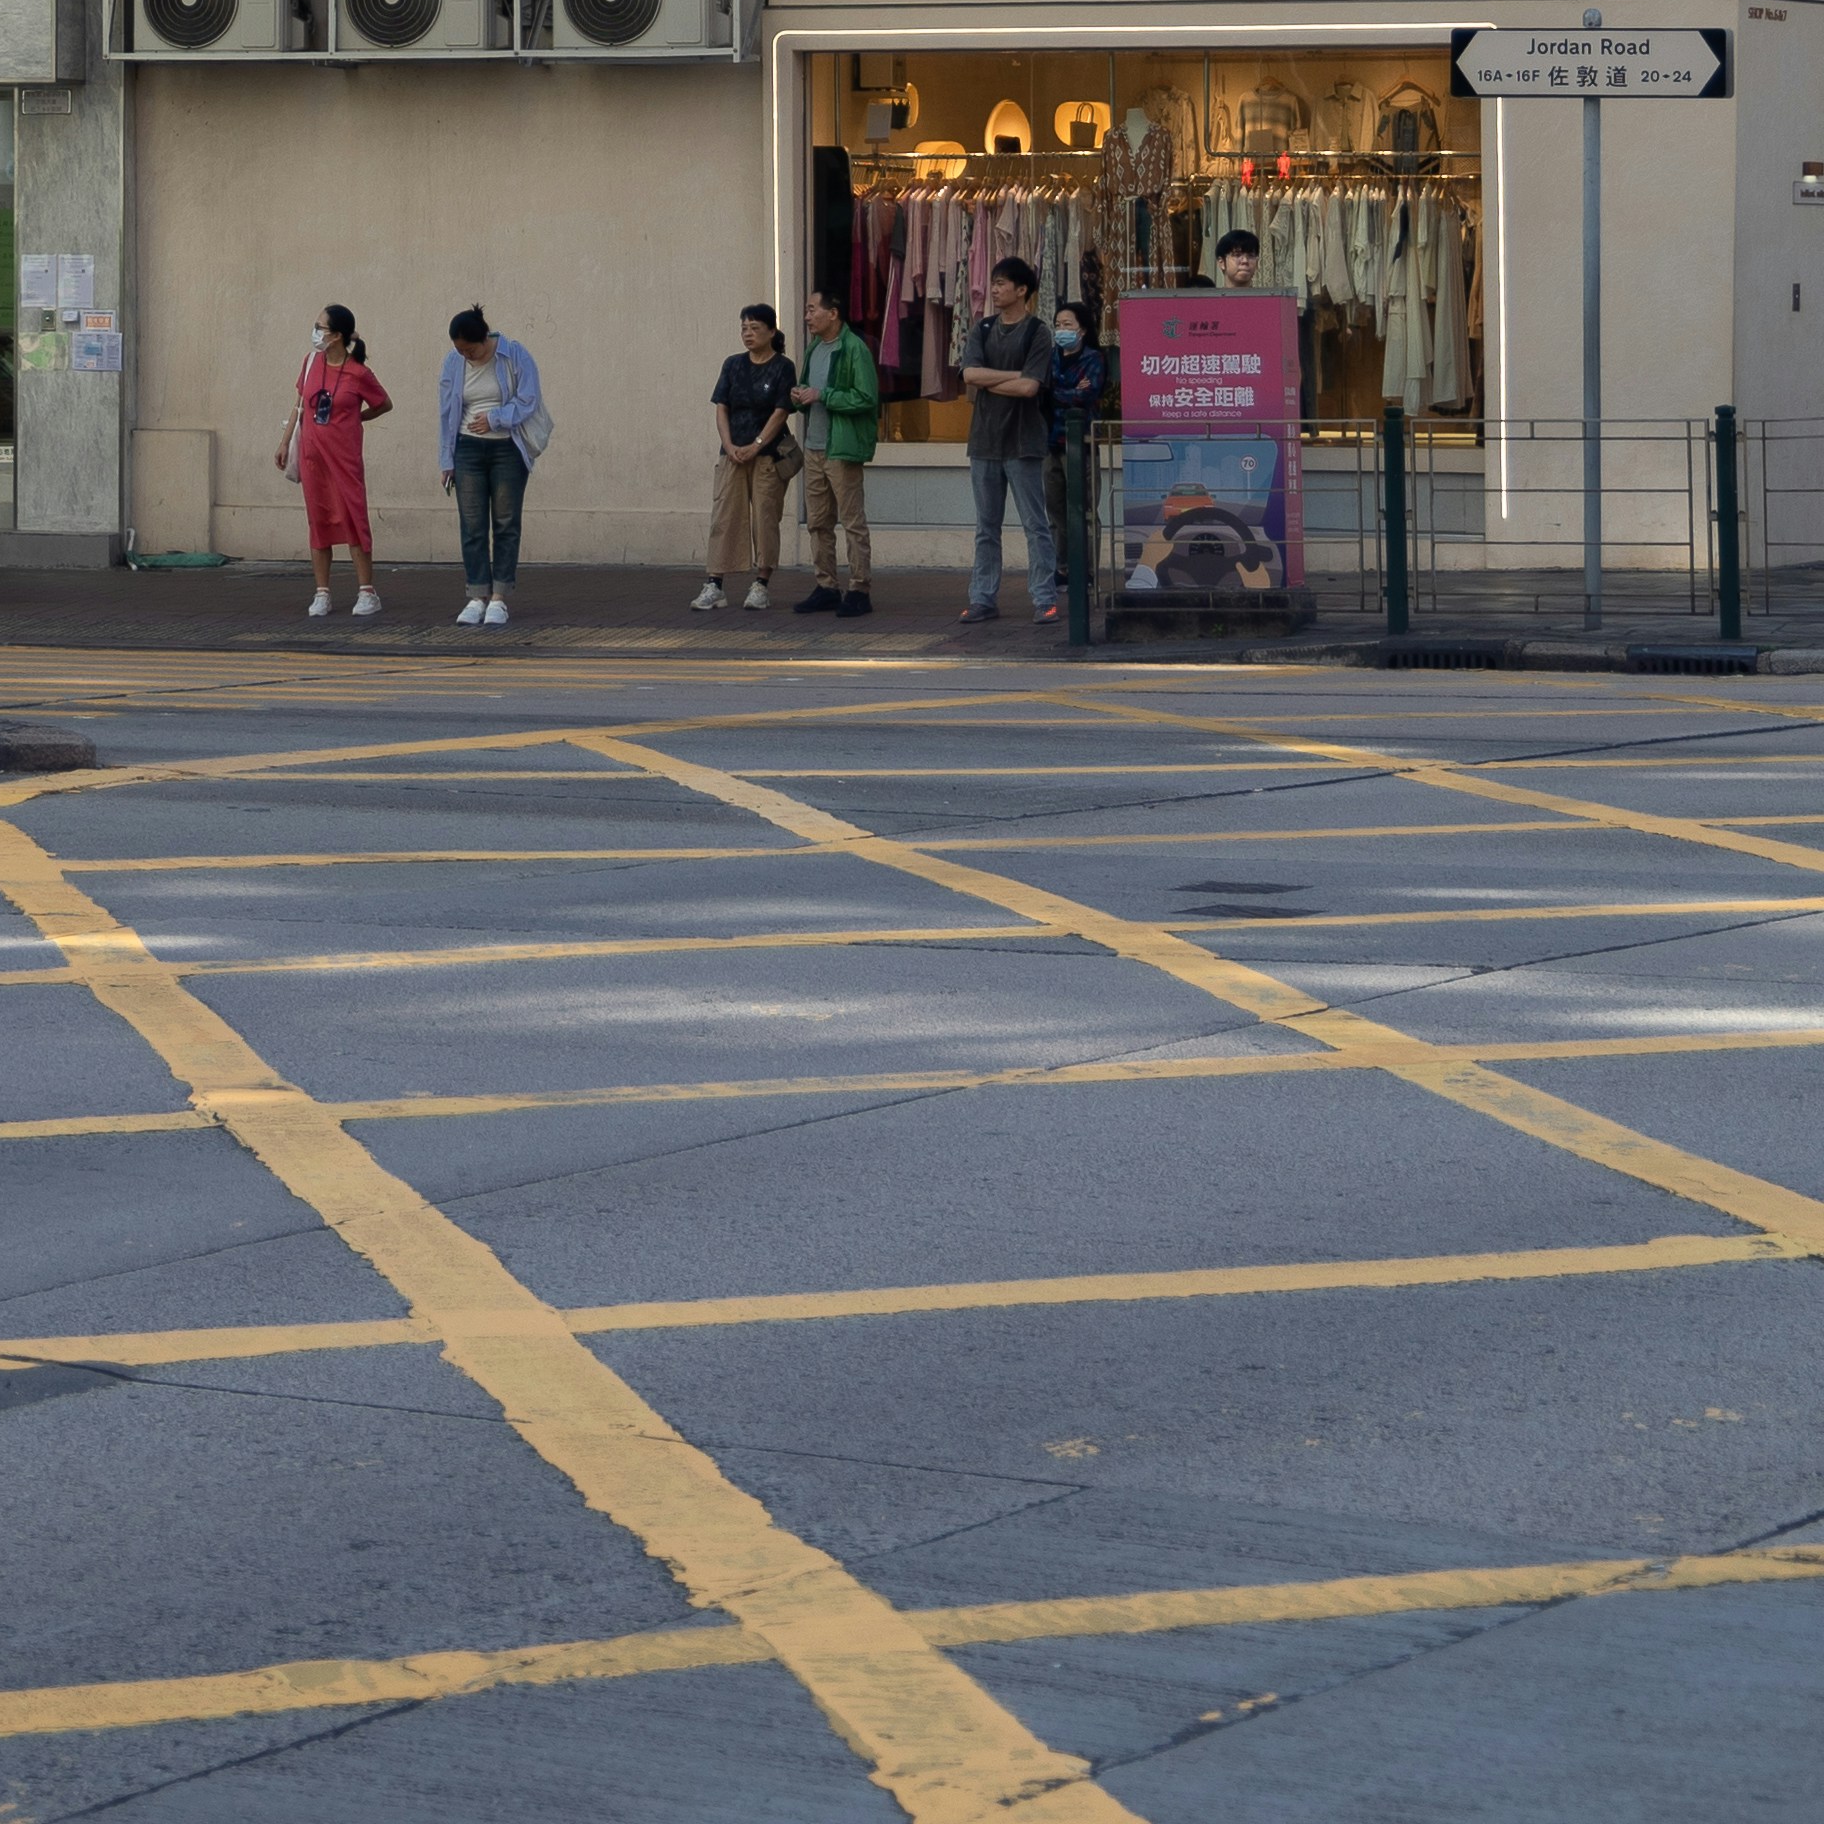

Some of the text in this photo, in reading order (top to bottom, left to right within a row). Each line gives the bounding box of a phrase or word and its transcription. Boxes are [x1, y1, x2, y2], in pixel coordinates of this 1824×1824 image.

[1748, 8, 1764, 20] SHOP
[1527, 37, 1651, 55] Jordan Road
[1548, 65, 1628, 88] 佐敦道
[1141, 353, 1262, 375] 切勿超速駕駛
[1176, 376, 1223, 385] No speeding
[1149, 386, 1255, 408] 保持安全距離
[1208, 410, 1242, 418] distance
[1243, 459, 1255, 468] 70
